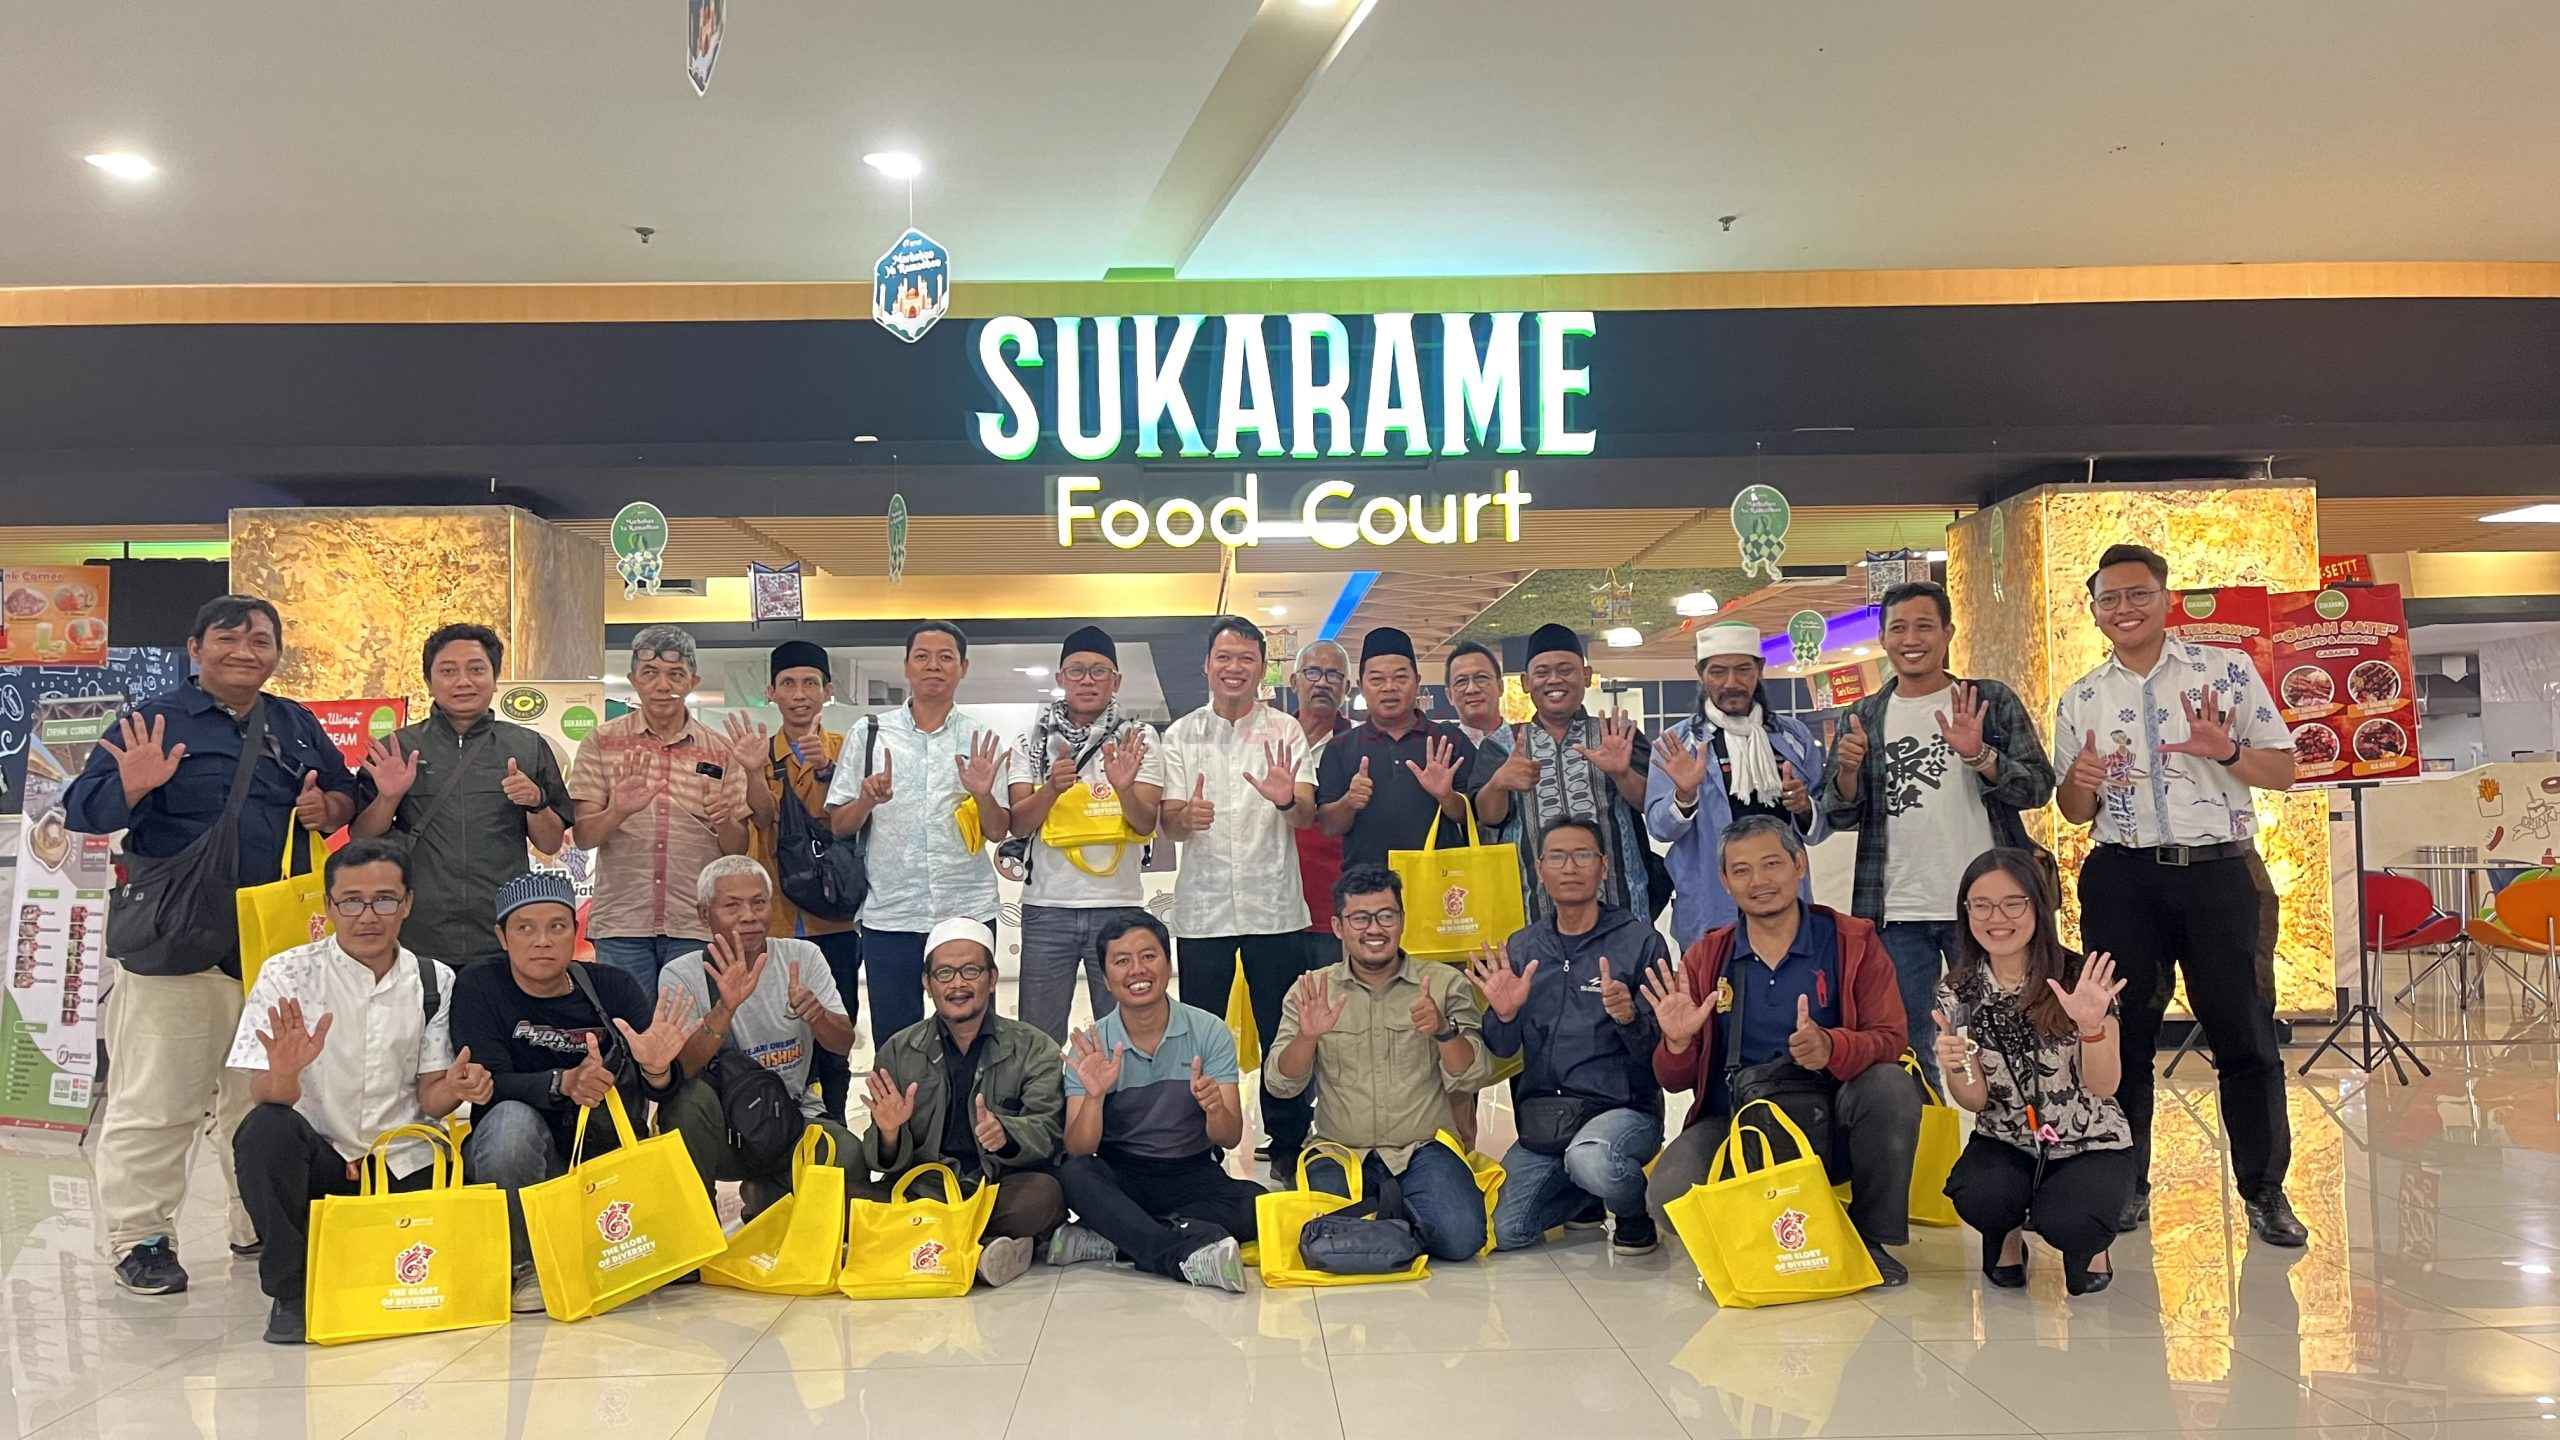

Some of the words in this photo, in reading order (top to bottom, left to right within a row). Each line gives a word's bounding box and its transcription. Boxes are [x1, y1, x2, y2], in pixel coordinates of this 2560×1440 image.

[976, 312, 1597, 460] SUKARAME
[1057, 473, 1258, 549] Food
[1303, 470, 1533, 549] Court
[328, 732, 358, 747] REAM
[598, 1259, 609, 1268] OF
[613, 1240, 656, 1264] DIVERSITY
[602, 1247, 619, 1258] THE
[620, 1234, 648, 1251] GLORY
[1774, 1263, 1785, 1272] OF
[1786, 1256, 1829, 1269] DIVERSITY
[1777, 1254, 1793, 1263] THE
[1794, 1249, 1821, 1261] GLORY
[389, 1288, 406, 1297] THE
[407, 1286, 439, 1296] GLORY
[382, 1297, 395, 1306] OF
[396, 1295, 445, 1306] DIVERSITY
